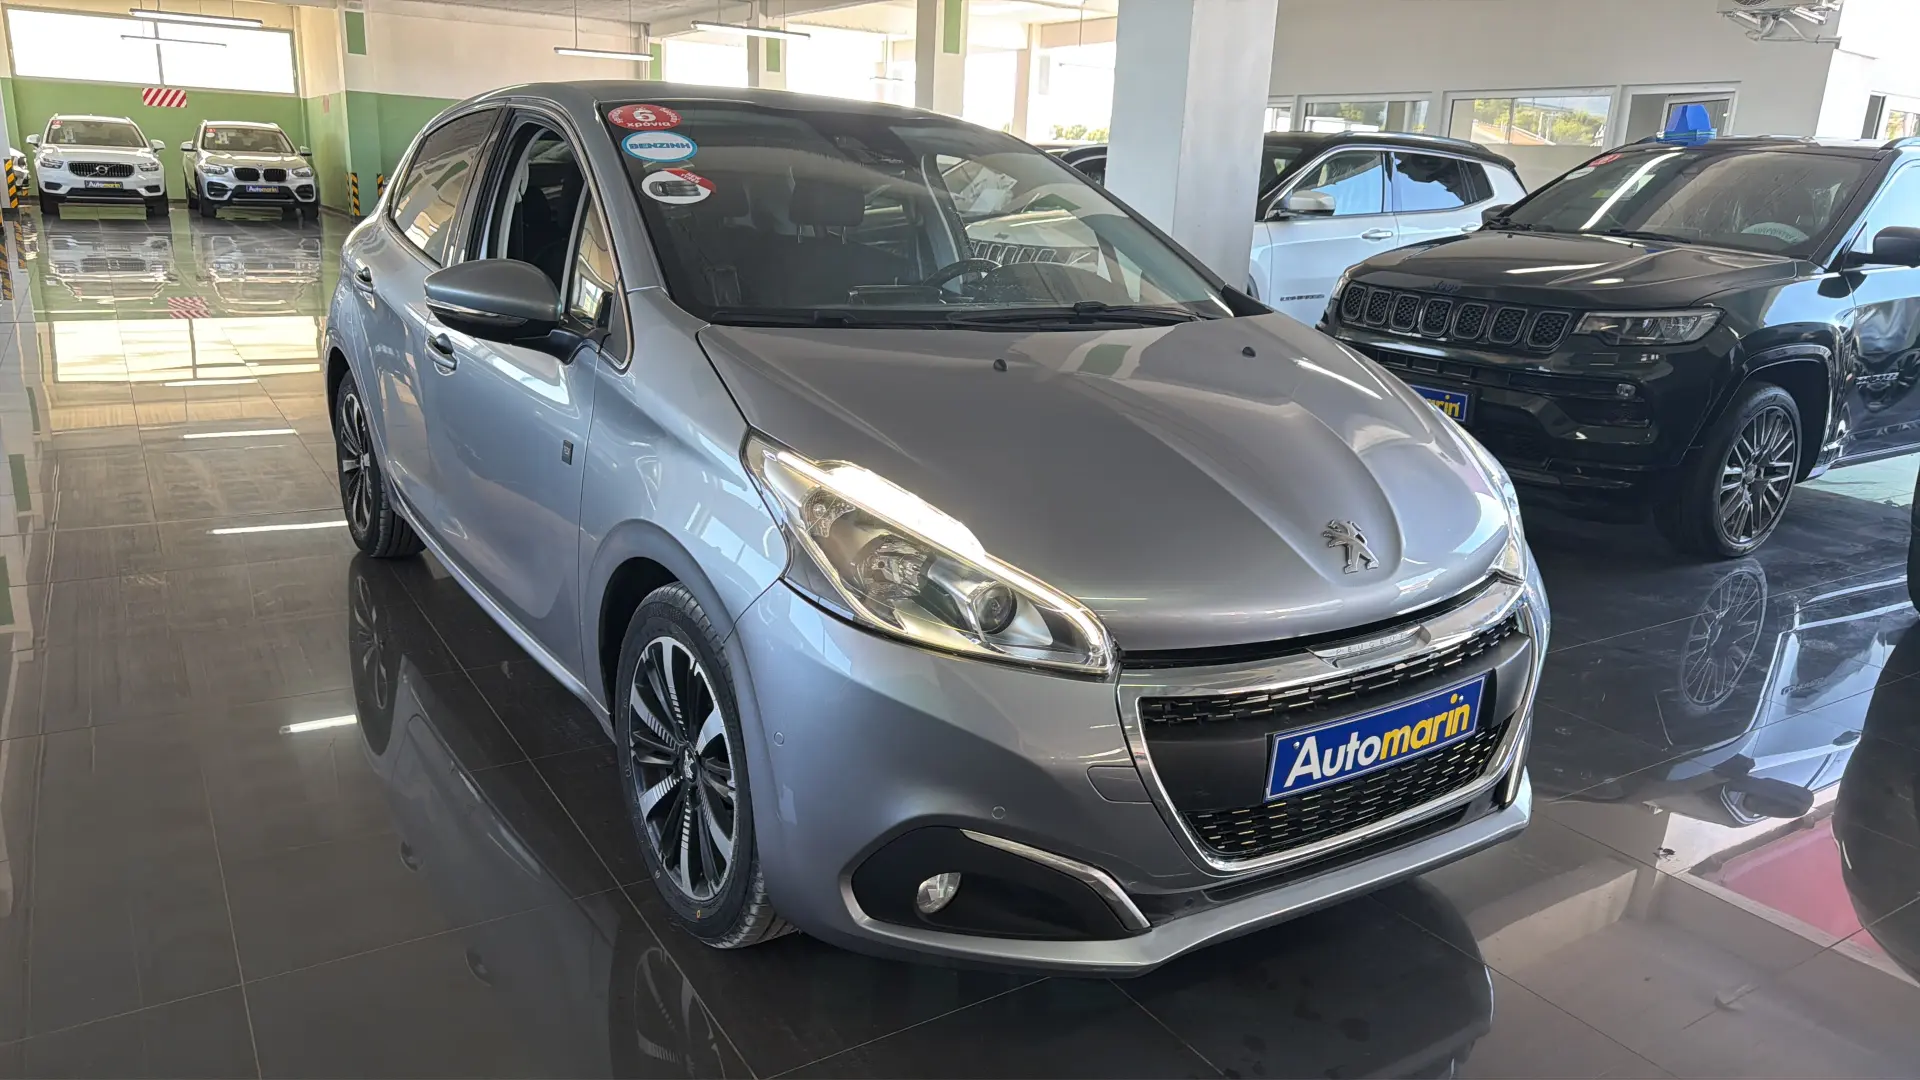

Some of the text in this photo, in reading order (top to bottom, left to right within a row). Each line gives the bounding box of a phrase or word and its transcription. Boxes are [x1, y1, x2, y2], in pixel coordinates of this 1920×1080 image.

[632, 109, 657, 122] 6
[1335, 632, 1405, 654] PEUGEOT
[1284, 693, 1470, 787] Automarin
